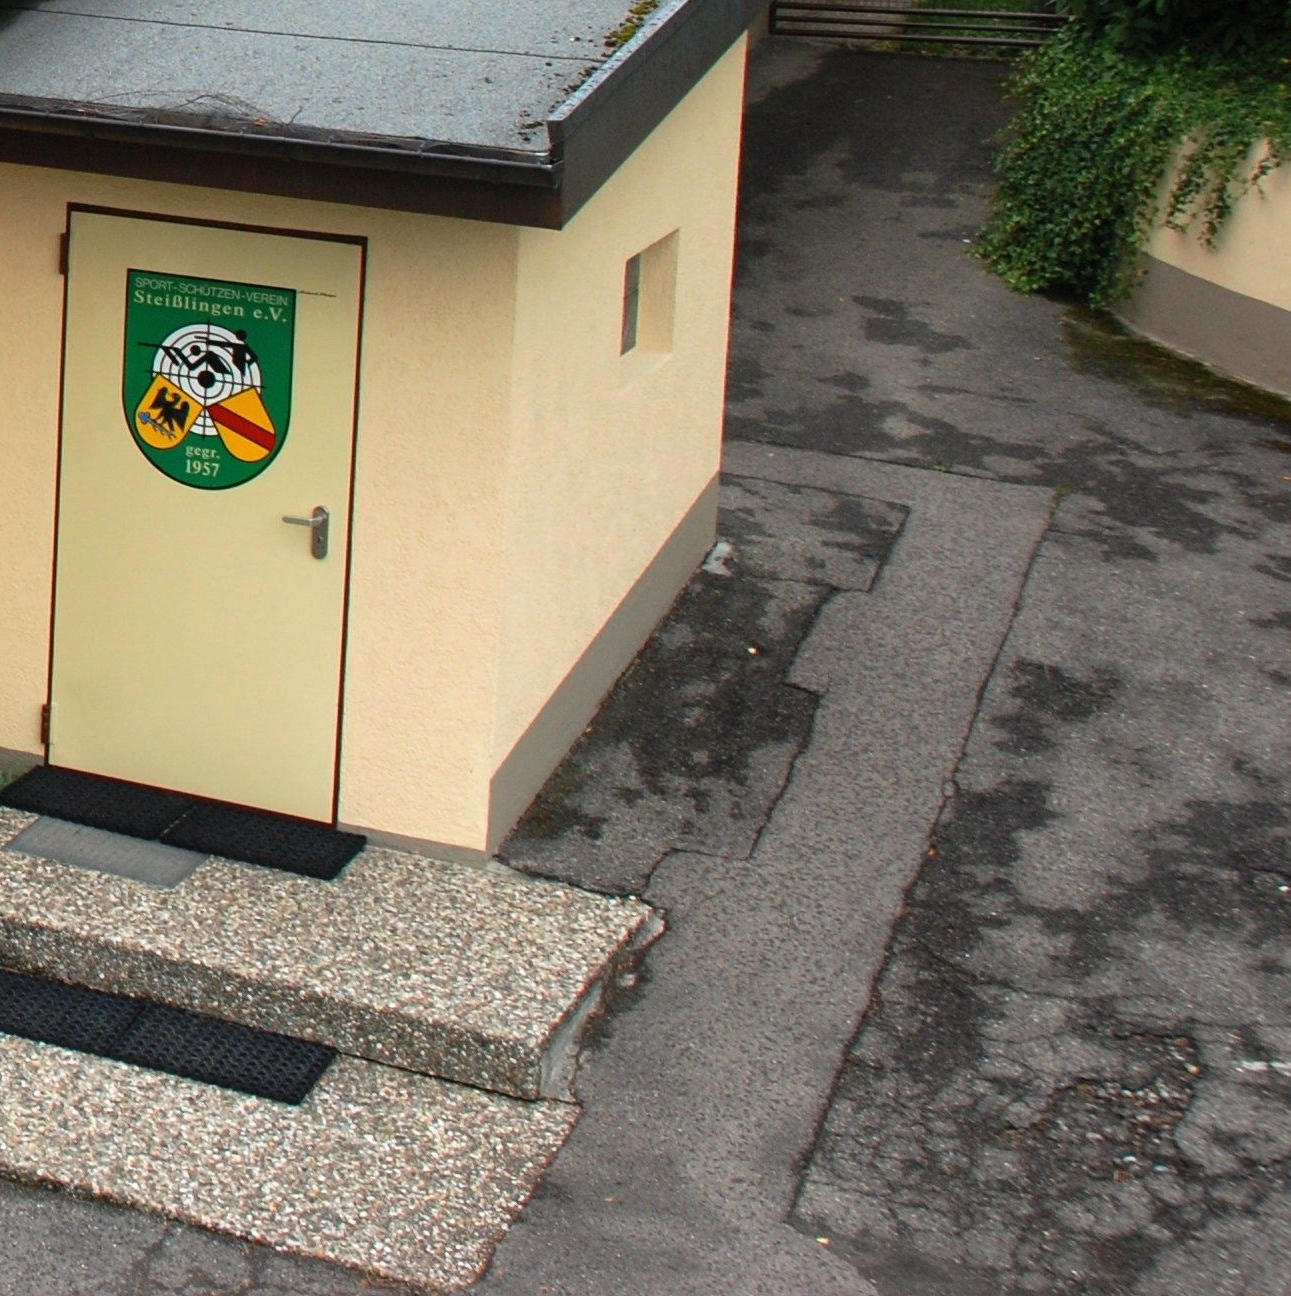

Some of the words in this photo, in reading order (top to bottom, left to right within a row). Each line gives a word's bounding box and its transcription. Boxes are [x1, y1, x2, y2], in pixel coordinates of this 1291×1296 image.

[134, 289, 245, 317] Steißlingen
[252, 306, 288, 322] e.V.
[185, 444, 221, 460] gegr.
[185, 459, 221, 478] 1957
